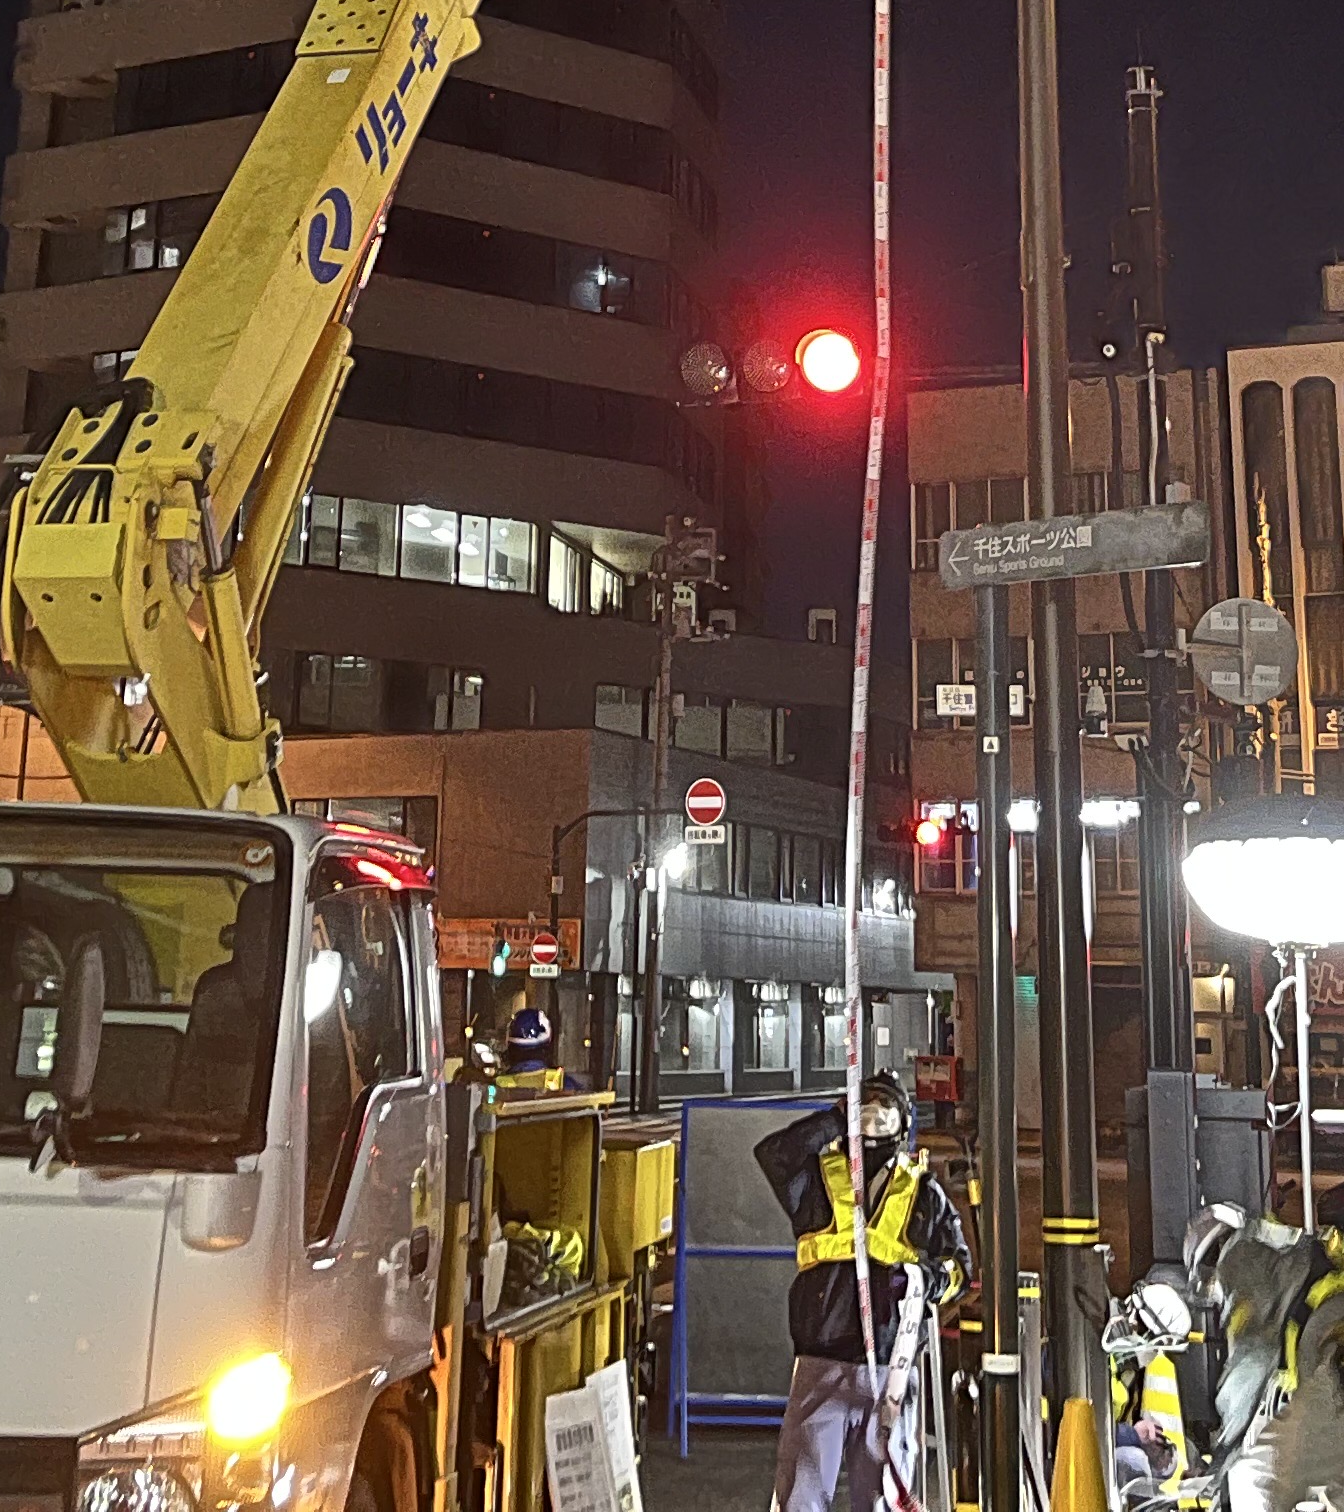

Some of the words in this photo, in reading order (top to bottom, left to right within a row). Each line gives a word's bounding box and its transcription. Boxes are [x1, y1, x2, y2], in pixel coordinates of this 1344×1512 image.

[355, 12, 438, 175] リョーキ
[973, 526, 1092, 559] 千住スポーツ公園
[998, 559, 1028, 574] Sports
[1029, 554, 1065, 569] Ground
